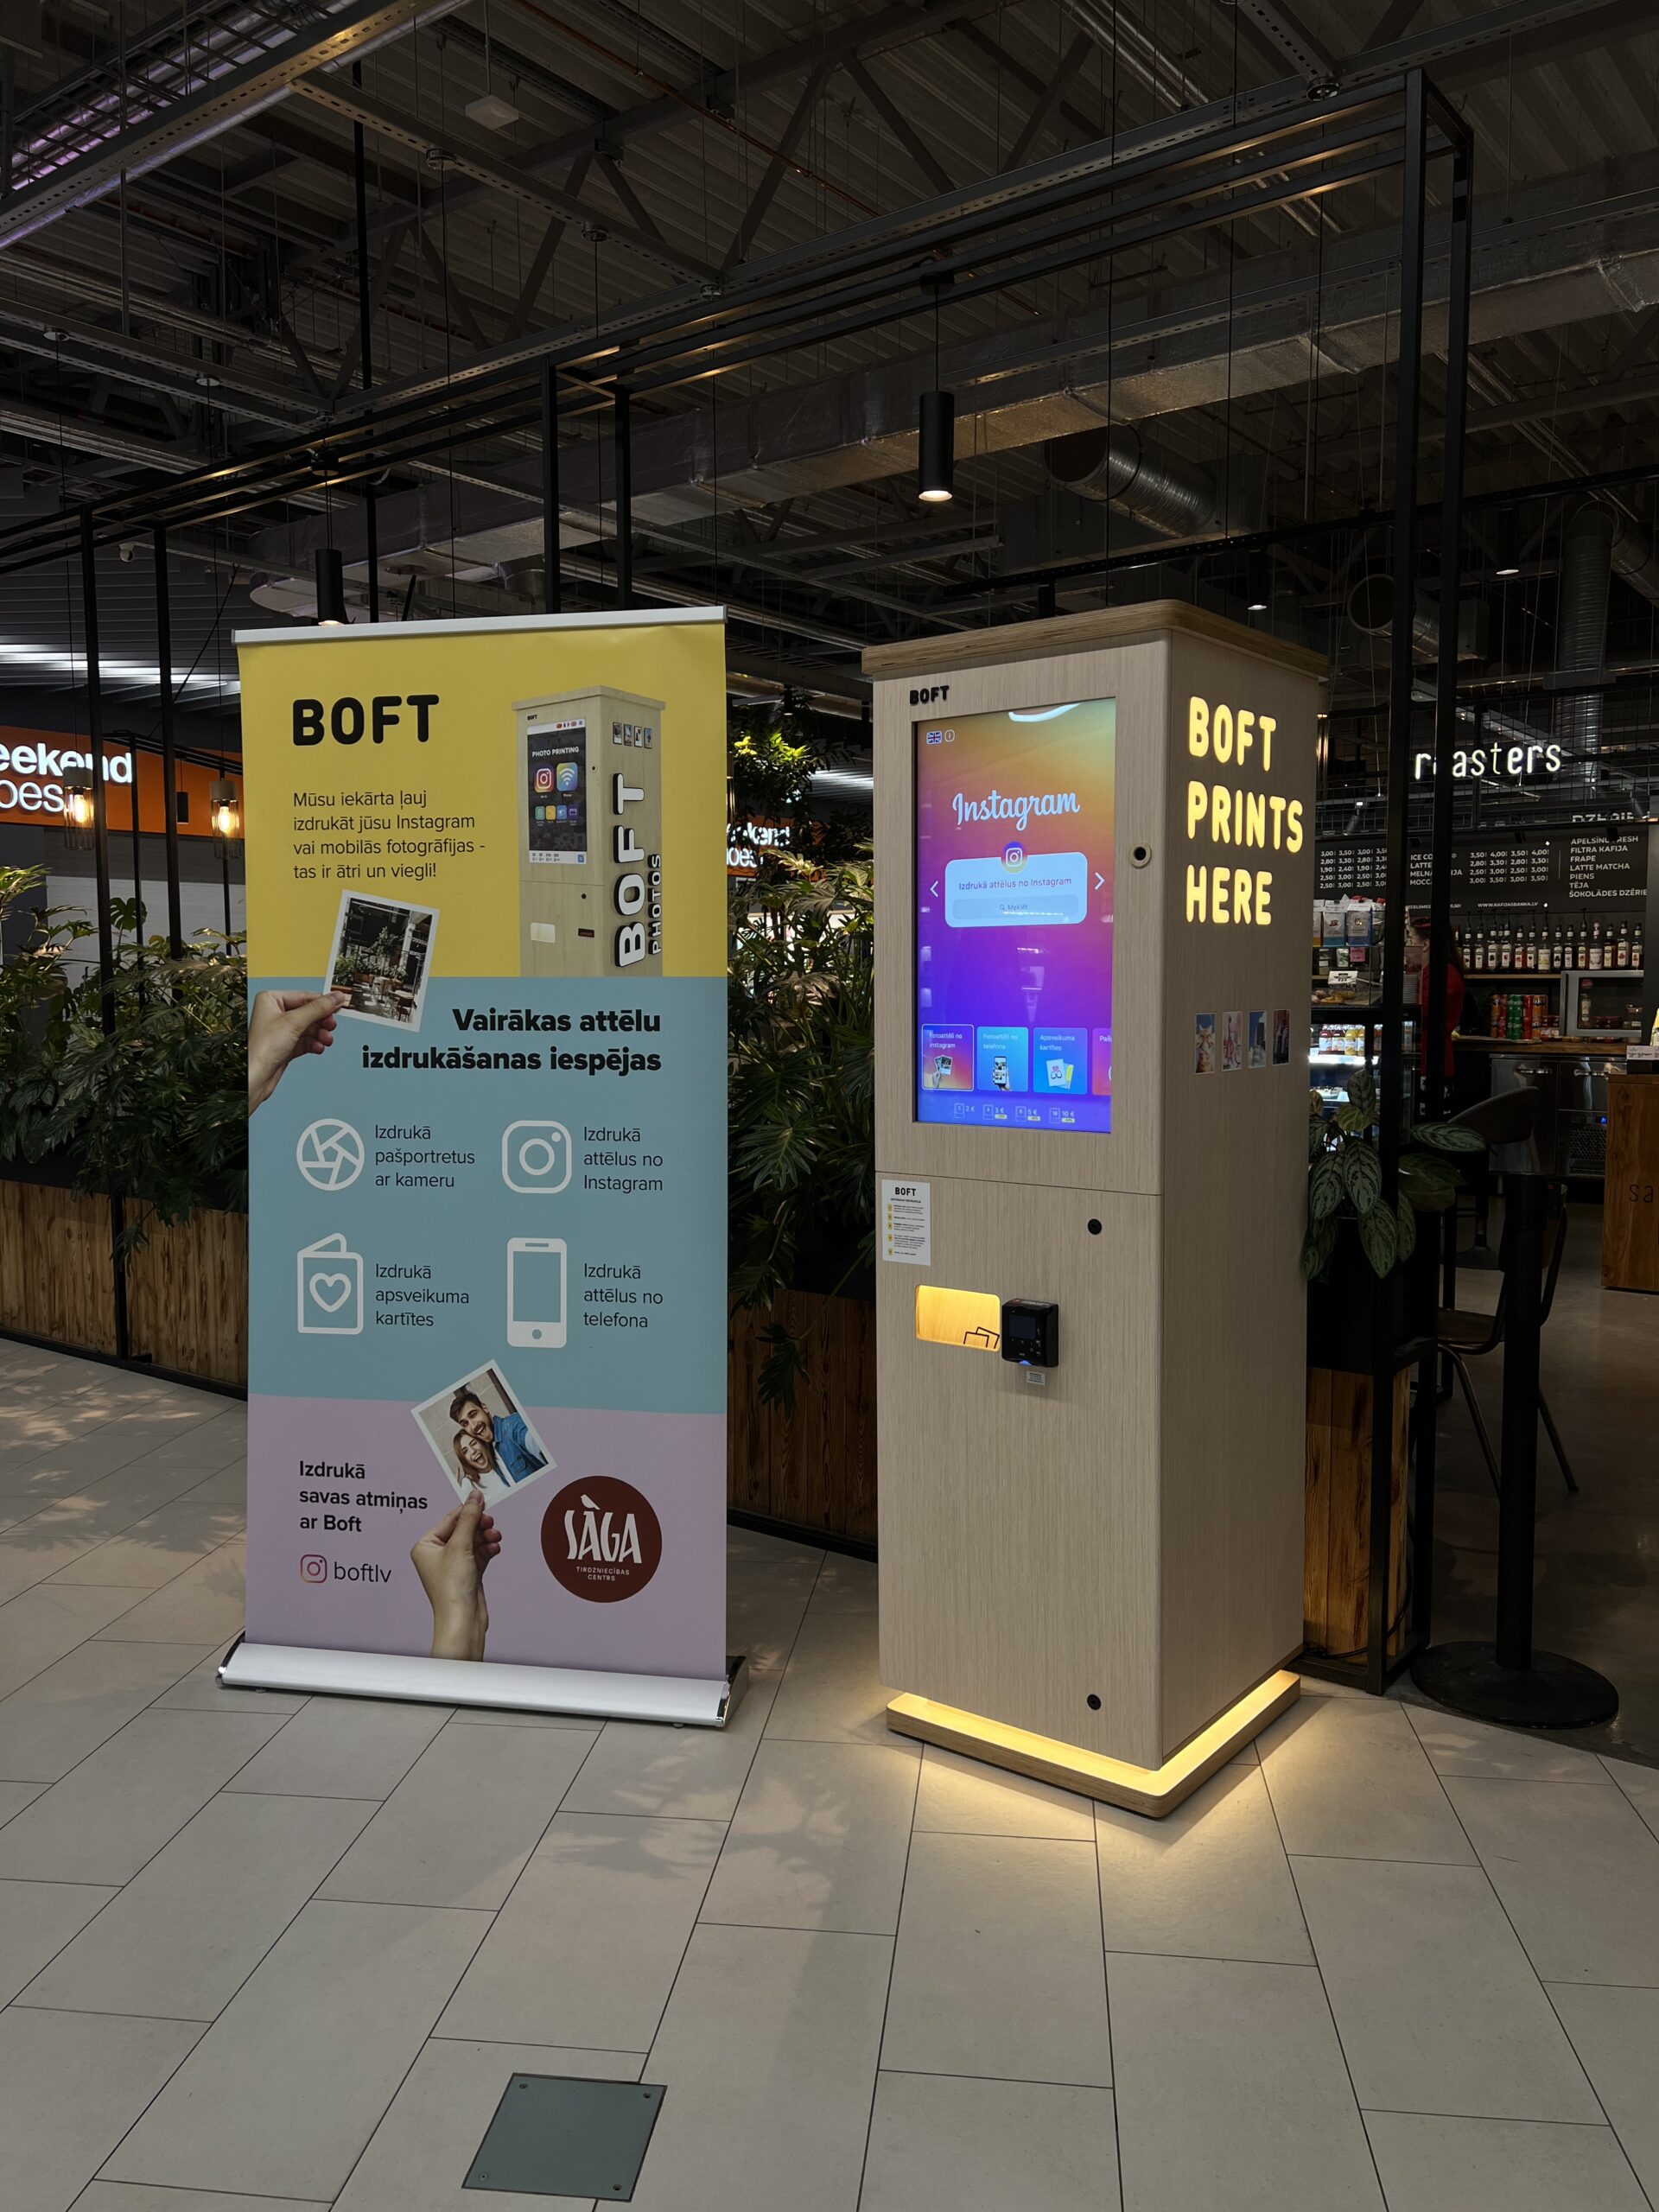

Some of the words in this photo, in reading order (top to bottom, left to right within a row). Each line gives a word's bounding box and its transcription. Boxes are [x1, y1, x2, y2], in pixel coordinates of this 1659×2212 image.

[910, 685, 950, 705] BOFT
[293, 695, 439, 747] BOFT
[1189, 696, 1276, 772] BOFT
[532, 749, 550, 758] PHOTO
[552, 746, 579, 755] PRINTING
[1414, 742, 1560, 779] rasters
[294, 792, 334, 806] Mūsu
[341, 791, 393, 805] iekārta
[401, 791, 426, 810] ļauj
[952, 790, 1081, 831] Instagram
[1187, 780, 1303, 854] PRINTS
[294, 817, 354, 830] izdrukāt
[358, 816, 391, 833] jūsu
[397, 815, 474, 832] Instagram
[294, 841, 315, 855] vai
[321, 840, 381, 854] mobilās
[386, 838, 474, 856] fotogrāfijas
[294, 866, 316, 878] tas
[322, 865, 331, 878] ir
[337, 864, 360, 878] ātri
[367, 868, 385, 877] un
[391, 863, 435, 880] viegli!
[613, 773, 646, 968] BOFT
[958, 880, 987, 891] Izdrukā
[989, 880, 1016, 889] attēlus
[1031, 878, 1071, 889] Instagram
[1185, 864, 1273, 925] HERE
[649, 854, 662, 955] PHOTOS
[452, 1007, 571, 1031] Vairākas
[580, 1009, 660, 1032] attēlu
[363, 1045, 541, 1070] izdrukāšanas
[550, 1046, 661, 1076] iespējas
[376, 1125, 430, 1139] Izdrukā
[585, 1127, 640, 1141] Izdrukā
[376, 1148, 474, 1166] pašportretus
[584, 1152, 636, 1166] attēlus
[643, 1156, 663, 1166] no
[376, 1175, 391, 1185] ar
[397, 1173, 454, 1187] kameru
[585, 1175, 662, 1193] Instagram
[894, 1186, 916, 1197] BOFT
[376, 1263, 430, 1279] Izdrukā
[585, 1263, 640, 1279] Izdrukā
[376, 1289, 468, 1305] apsveikuma
[584, 1288, 637, 1303] attēlus
[644, 1294, 663, 1304] no
[377, 1311, 434, 1326] kartītes
[584, 1312, 647, 1327] telefona
[300, 1461, 365, 1478] Izdrukā
[300, 1491, 350, 1504] savas
[356, 1491, 428, 1514] atmiņas
[300, 1517, 317, 1529] ar
[324, 1515, 361, 1532] Boft
[334, 1561, 391, 1582] boftlv
[576, 1567, 629, 1575] TIRDZNIECĪBAS
